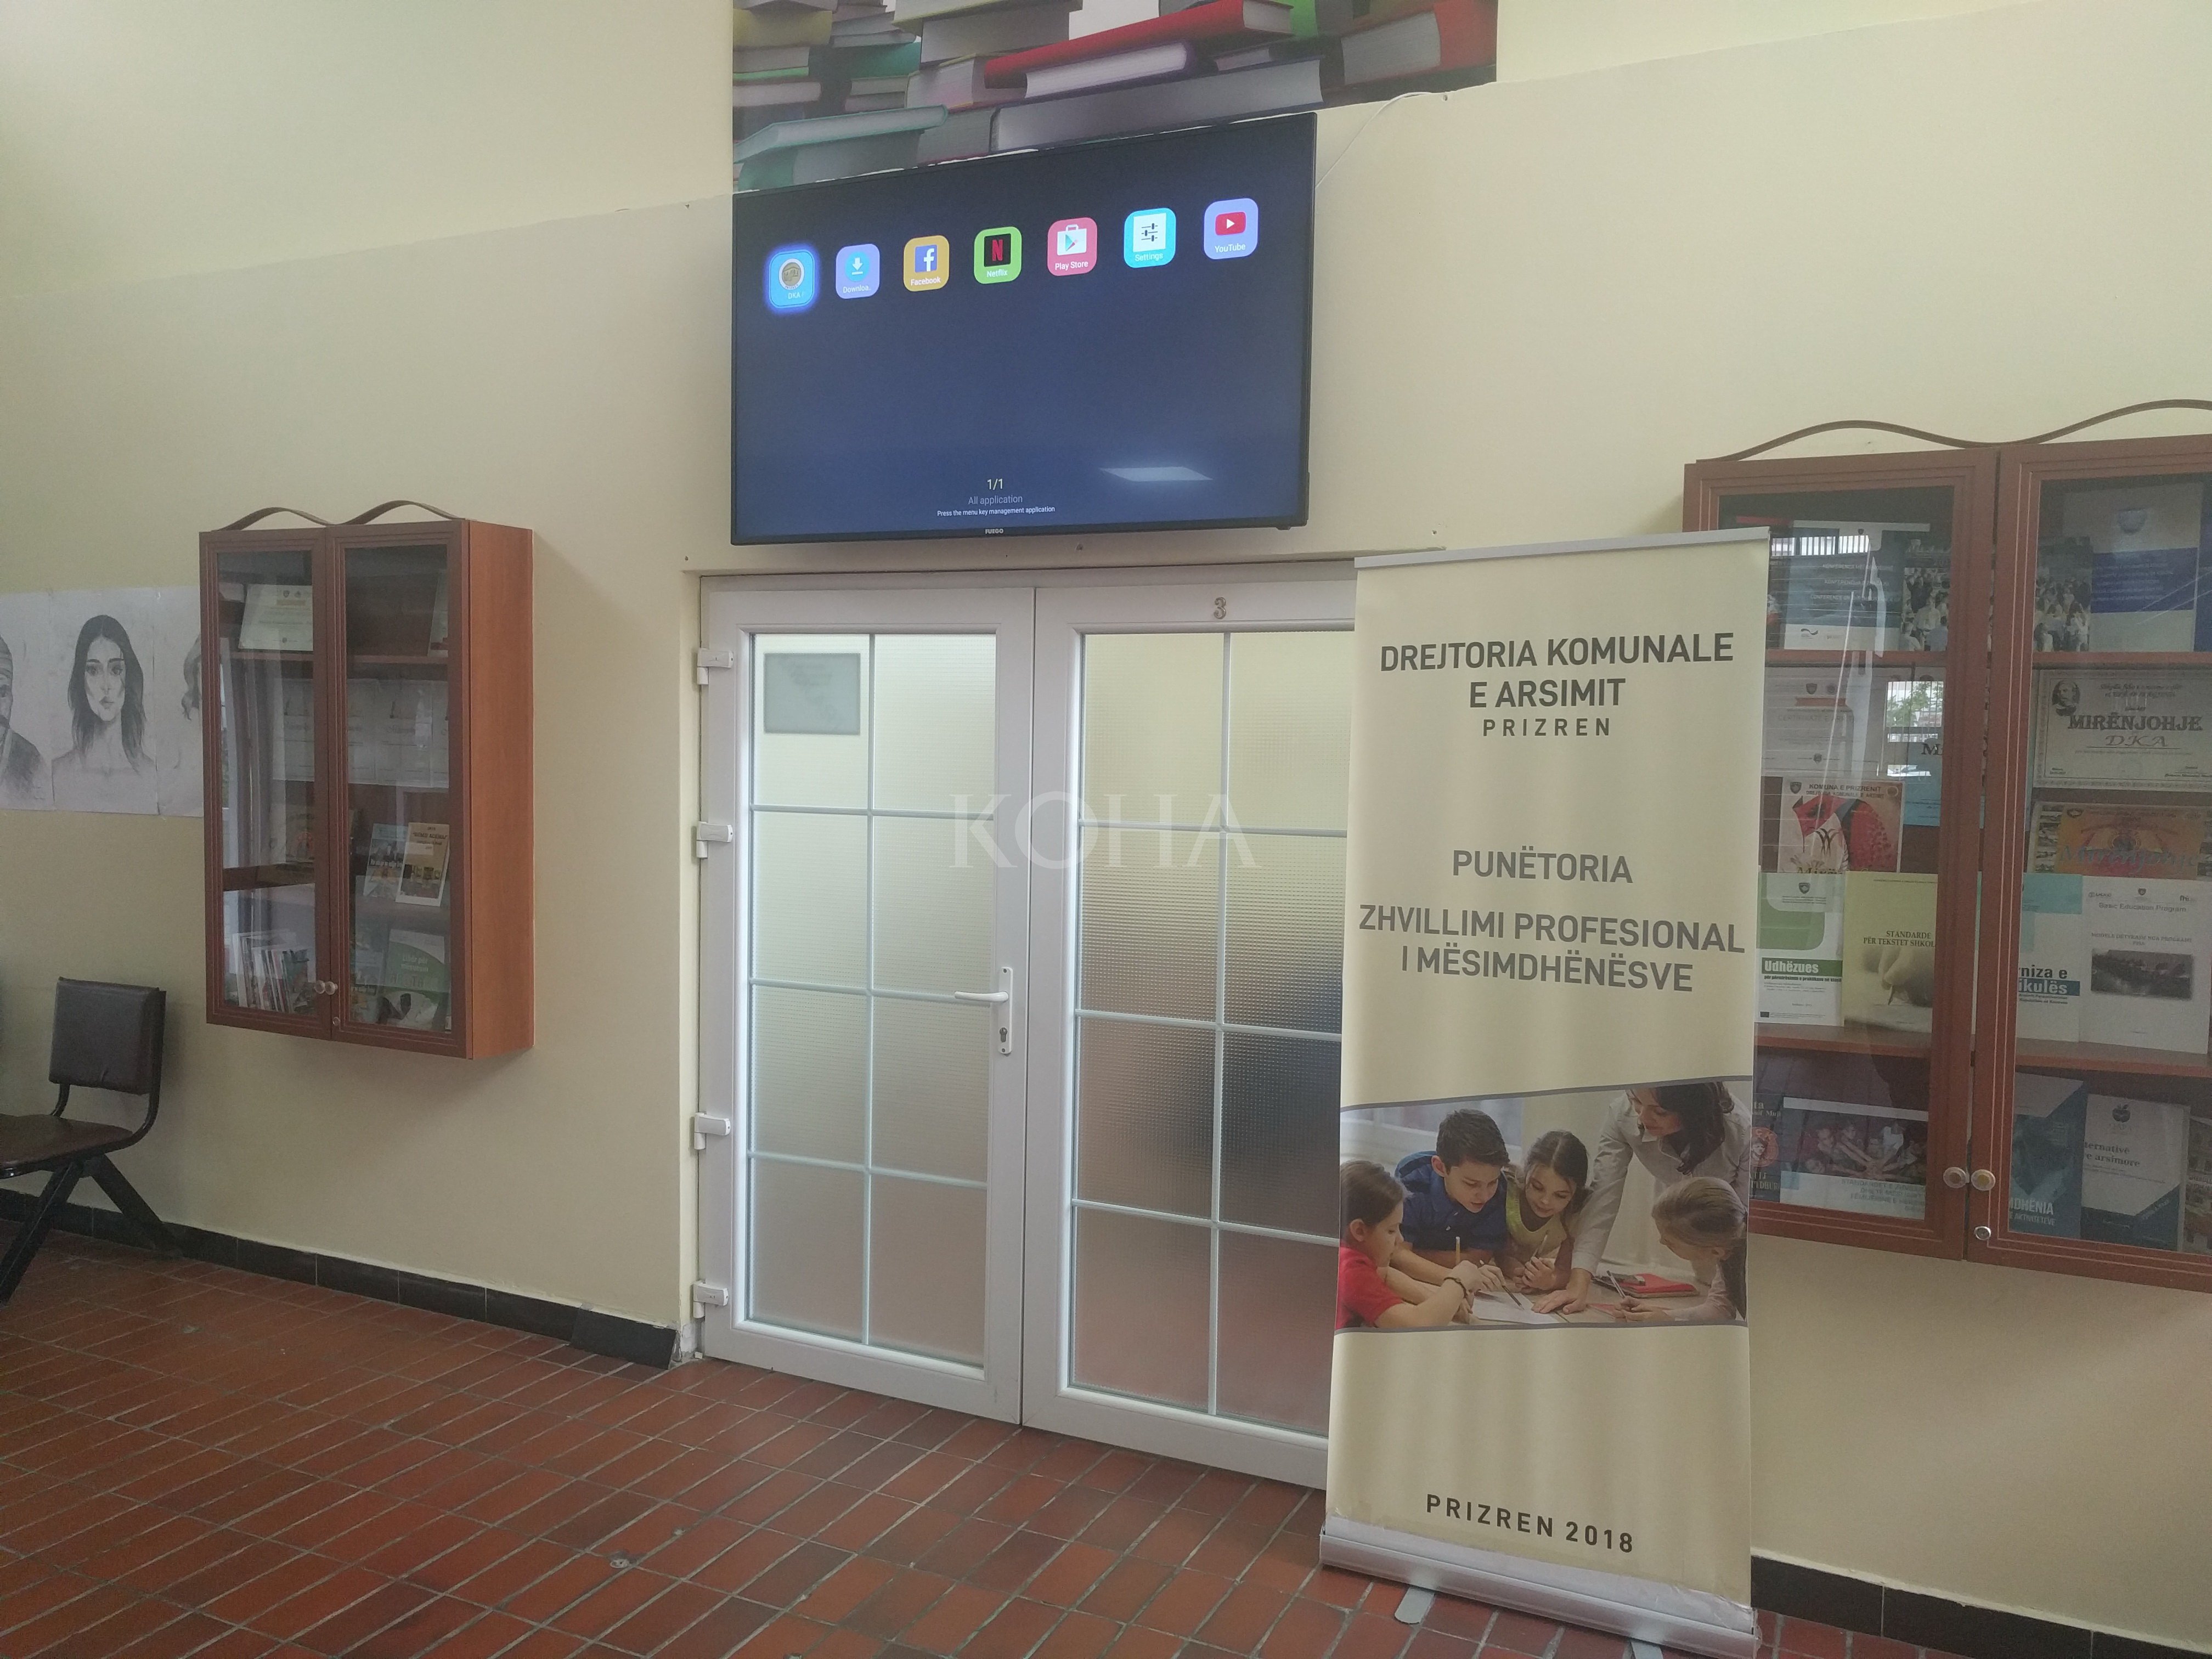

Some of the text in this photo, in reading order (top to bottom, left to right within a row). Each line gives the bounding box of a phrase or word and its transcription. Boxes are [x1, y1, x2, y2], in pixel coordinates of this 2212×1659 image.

[1215, 242, 1246, 253] YouTube
[1135, 252, 1164, 262] Settings
[1055, 260, 1088, 271] Play Store
[987, 269, 1008, 278] Netflix
[911, 276, 941, 286] Facebook
[987, 478, 1003, 490] 1/1
[968, 494, 1023, 505] All application
[1214, 597, 1227, 619] 3
[1380, 632, 1734, 672] DREJTORIA KOMUNALE
[1470, 678, 1626, 708] E ARSIMIT
[1483, 718, 1610, 737] PRIZREN
[2067, 712, 2203, 731] MIRËNJOHJE
[2105, 735, 2168, 747] DKA
[1453, 845, 1633, 884] PUNËTORIA
[2155, 905, 2187, 913] Program
[1359, 904, 1745, 954] ZHVILLIMI PROFESIONAL
[1886, 930, 1932, 939] STANDARDE
[1863, 936, 1936, 947] PËR TEKSTET SHKOL
[1402, 942, 1693, 992] I MËSIMDHËNËSVE
[1764, 960, 1819, 974] Udhëzues
[2019, 964, 2068, 979] niza e
[1427, 1493, 1633, 1553] PRIZREN 2018
